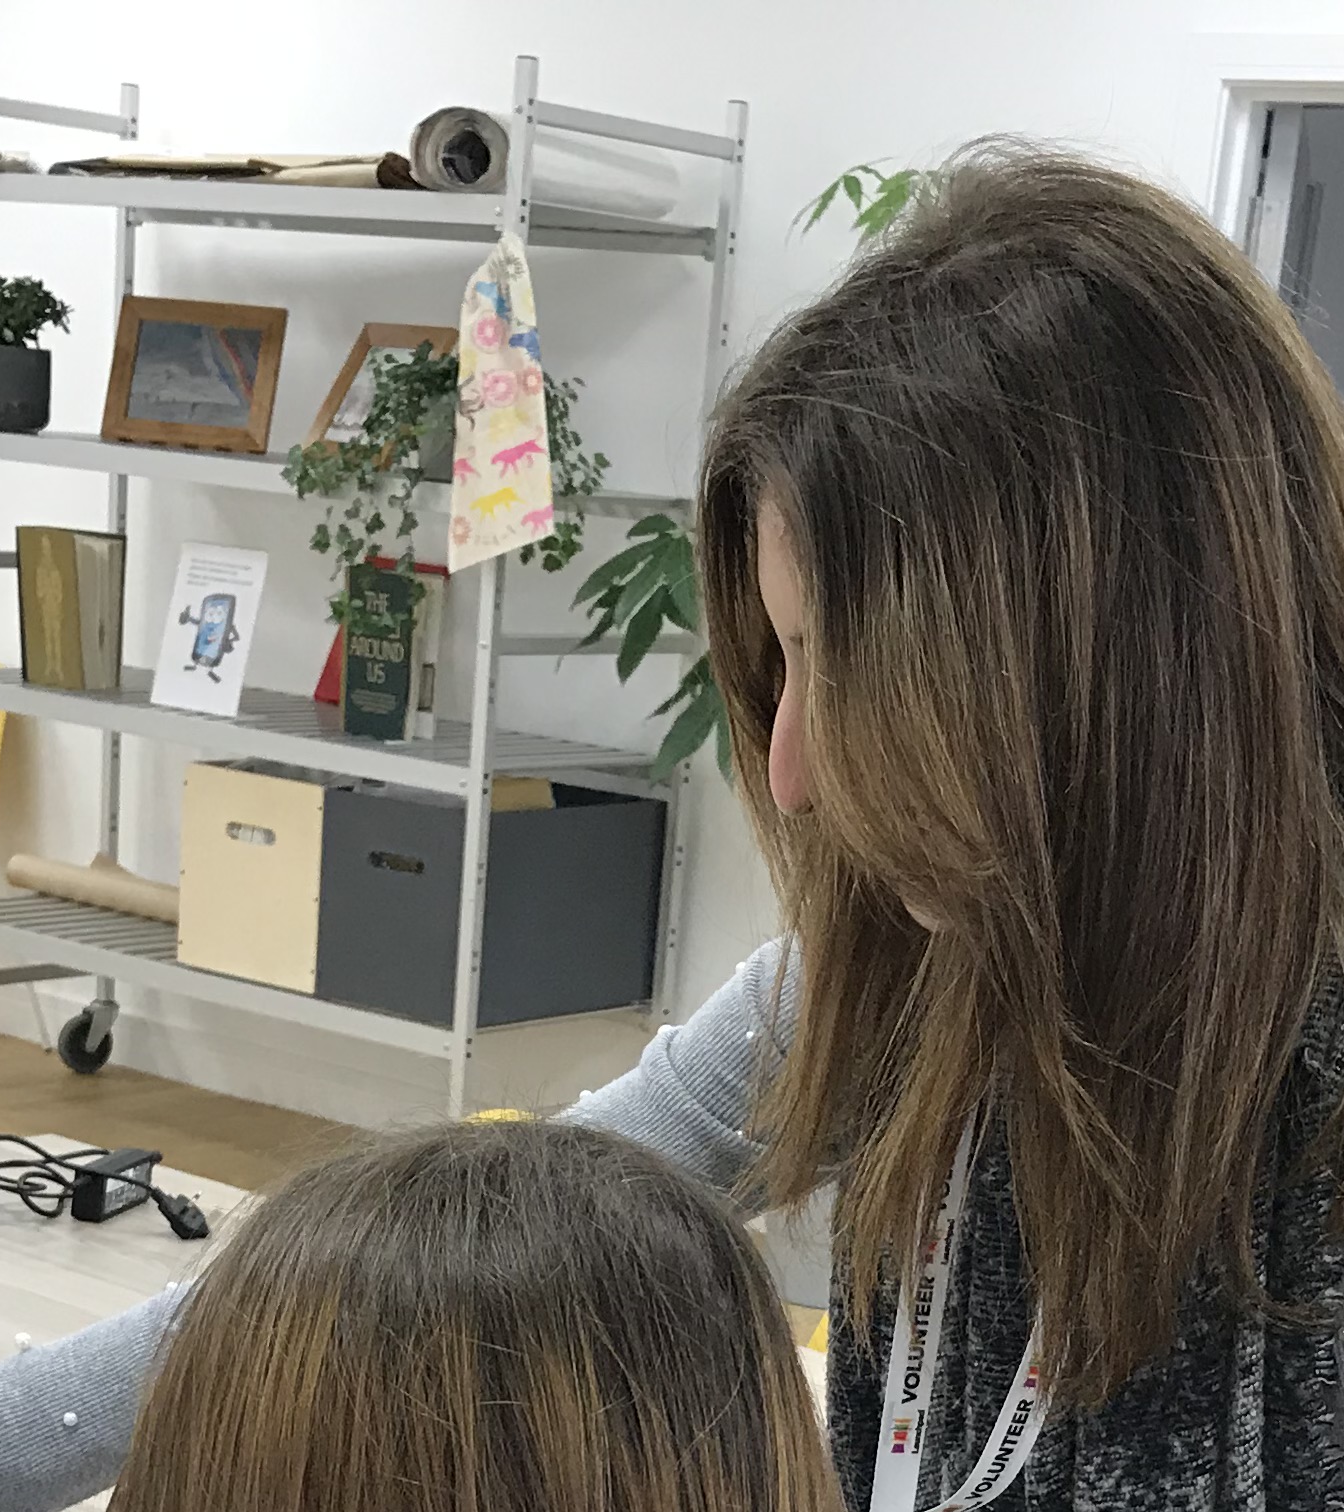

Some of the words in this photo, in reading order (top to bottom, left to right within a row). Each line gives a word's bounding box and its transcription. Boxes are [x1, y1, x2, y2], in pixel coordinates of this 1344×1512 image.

[365, 661, 387, 684] US
[901, 1275, 936, 1405] VOLUNTEER
[964, 1398, 1035, 1502] VOLUNTEER
